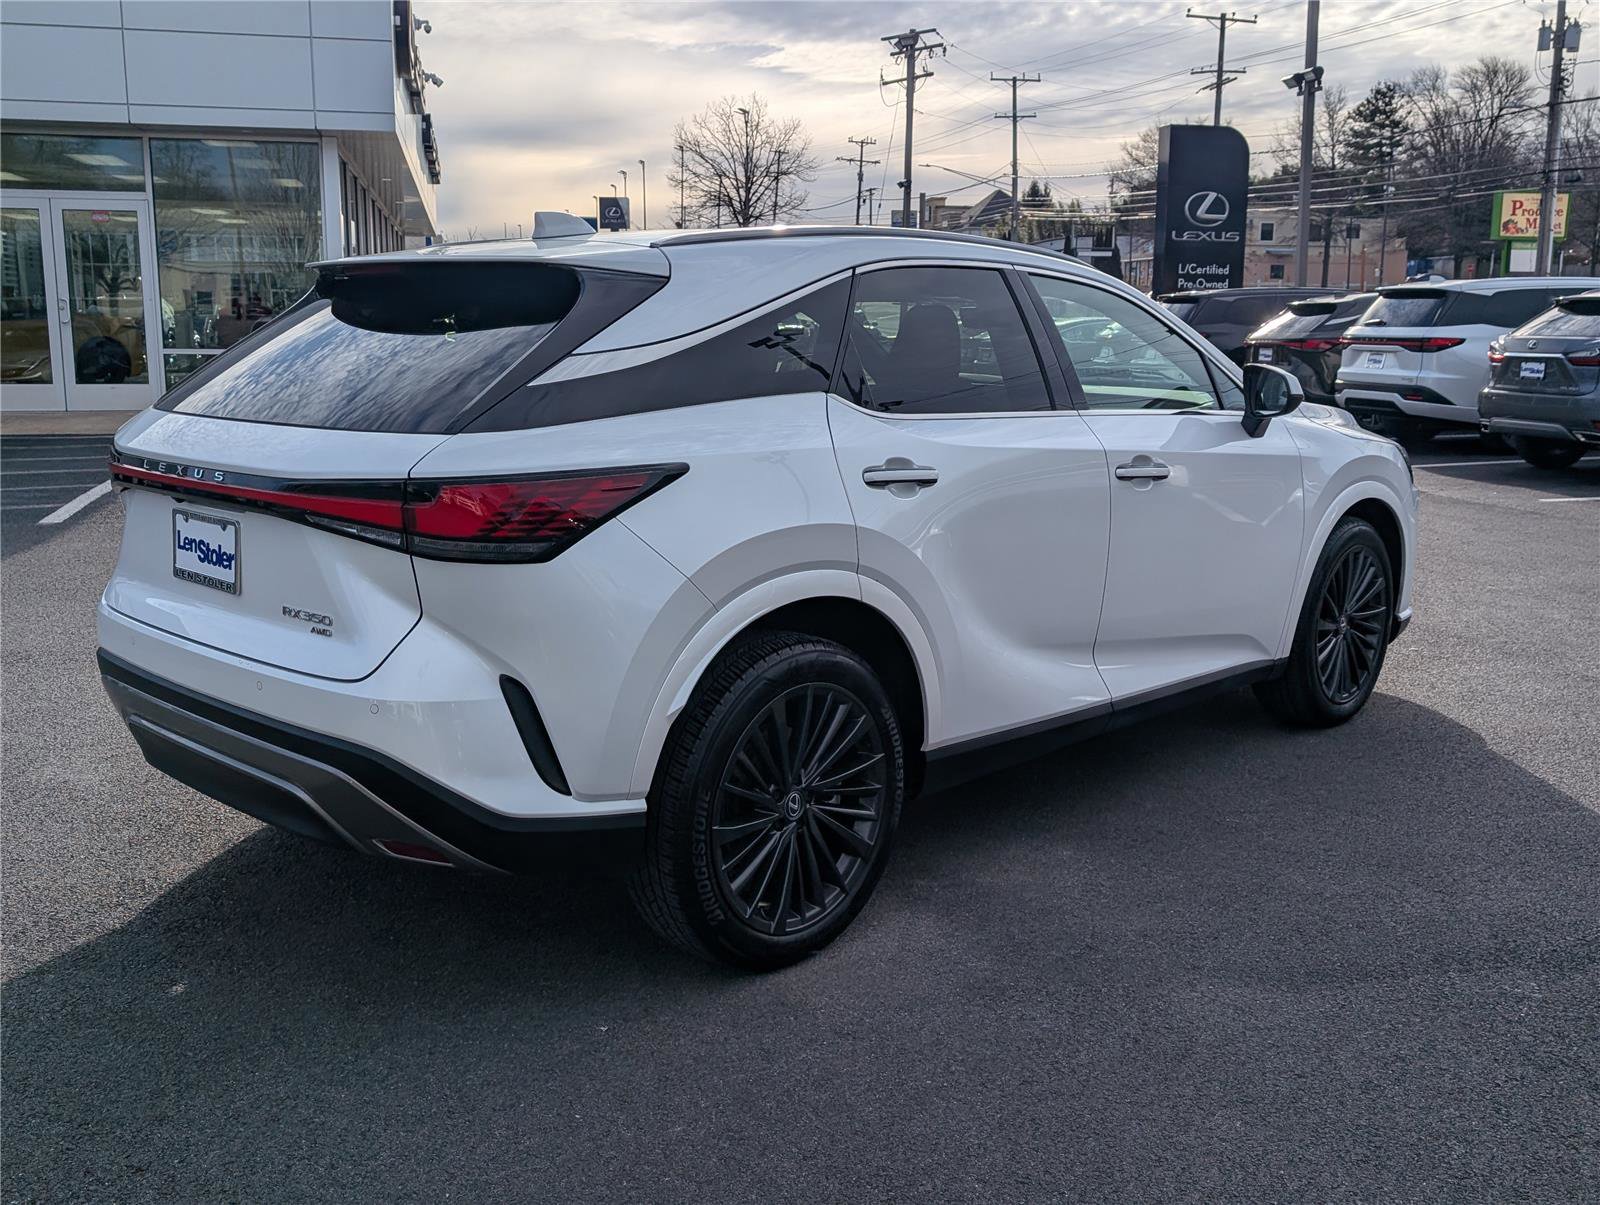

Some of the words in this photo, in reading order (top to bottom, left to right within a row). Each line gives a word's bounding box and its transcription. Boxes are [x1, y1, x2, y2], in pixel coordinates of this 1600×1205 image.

[1510, 199, 1564, 217] Prode
[1525, 217, 1562, 230] Met
[1171, 230, 1240, 242] LEXUS
[1178, 263, 1230, 275] L/Certified
[1177, 278, 1229, 289] Pre-Owned
[142, 459, 225, 482] LEXUS
[176, 568, 195, 581] LEN
[196, 574, 234, 593] STOLER
[310, 626, 333, 638] AWD
